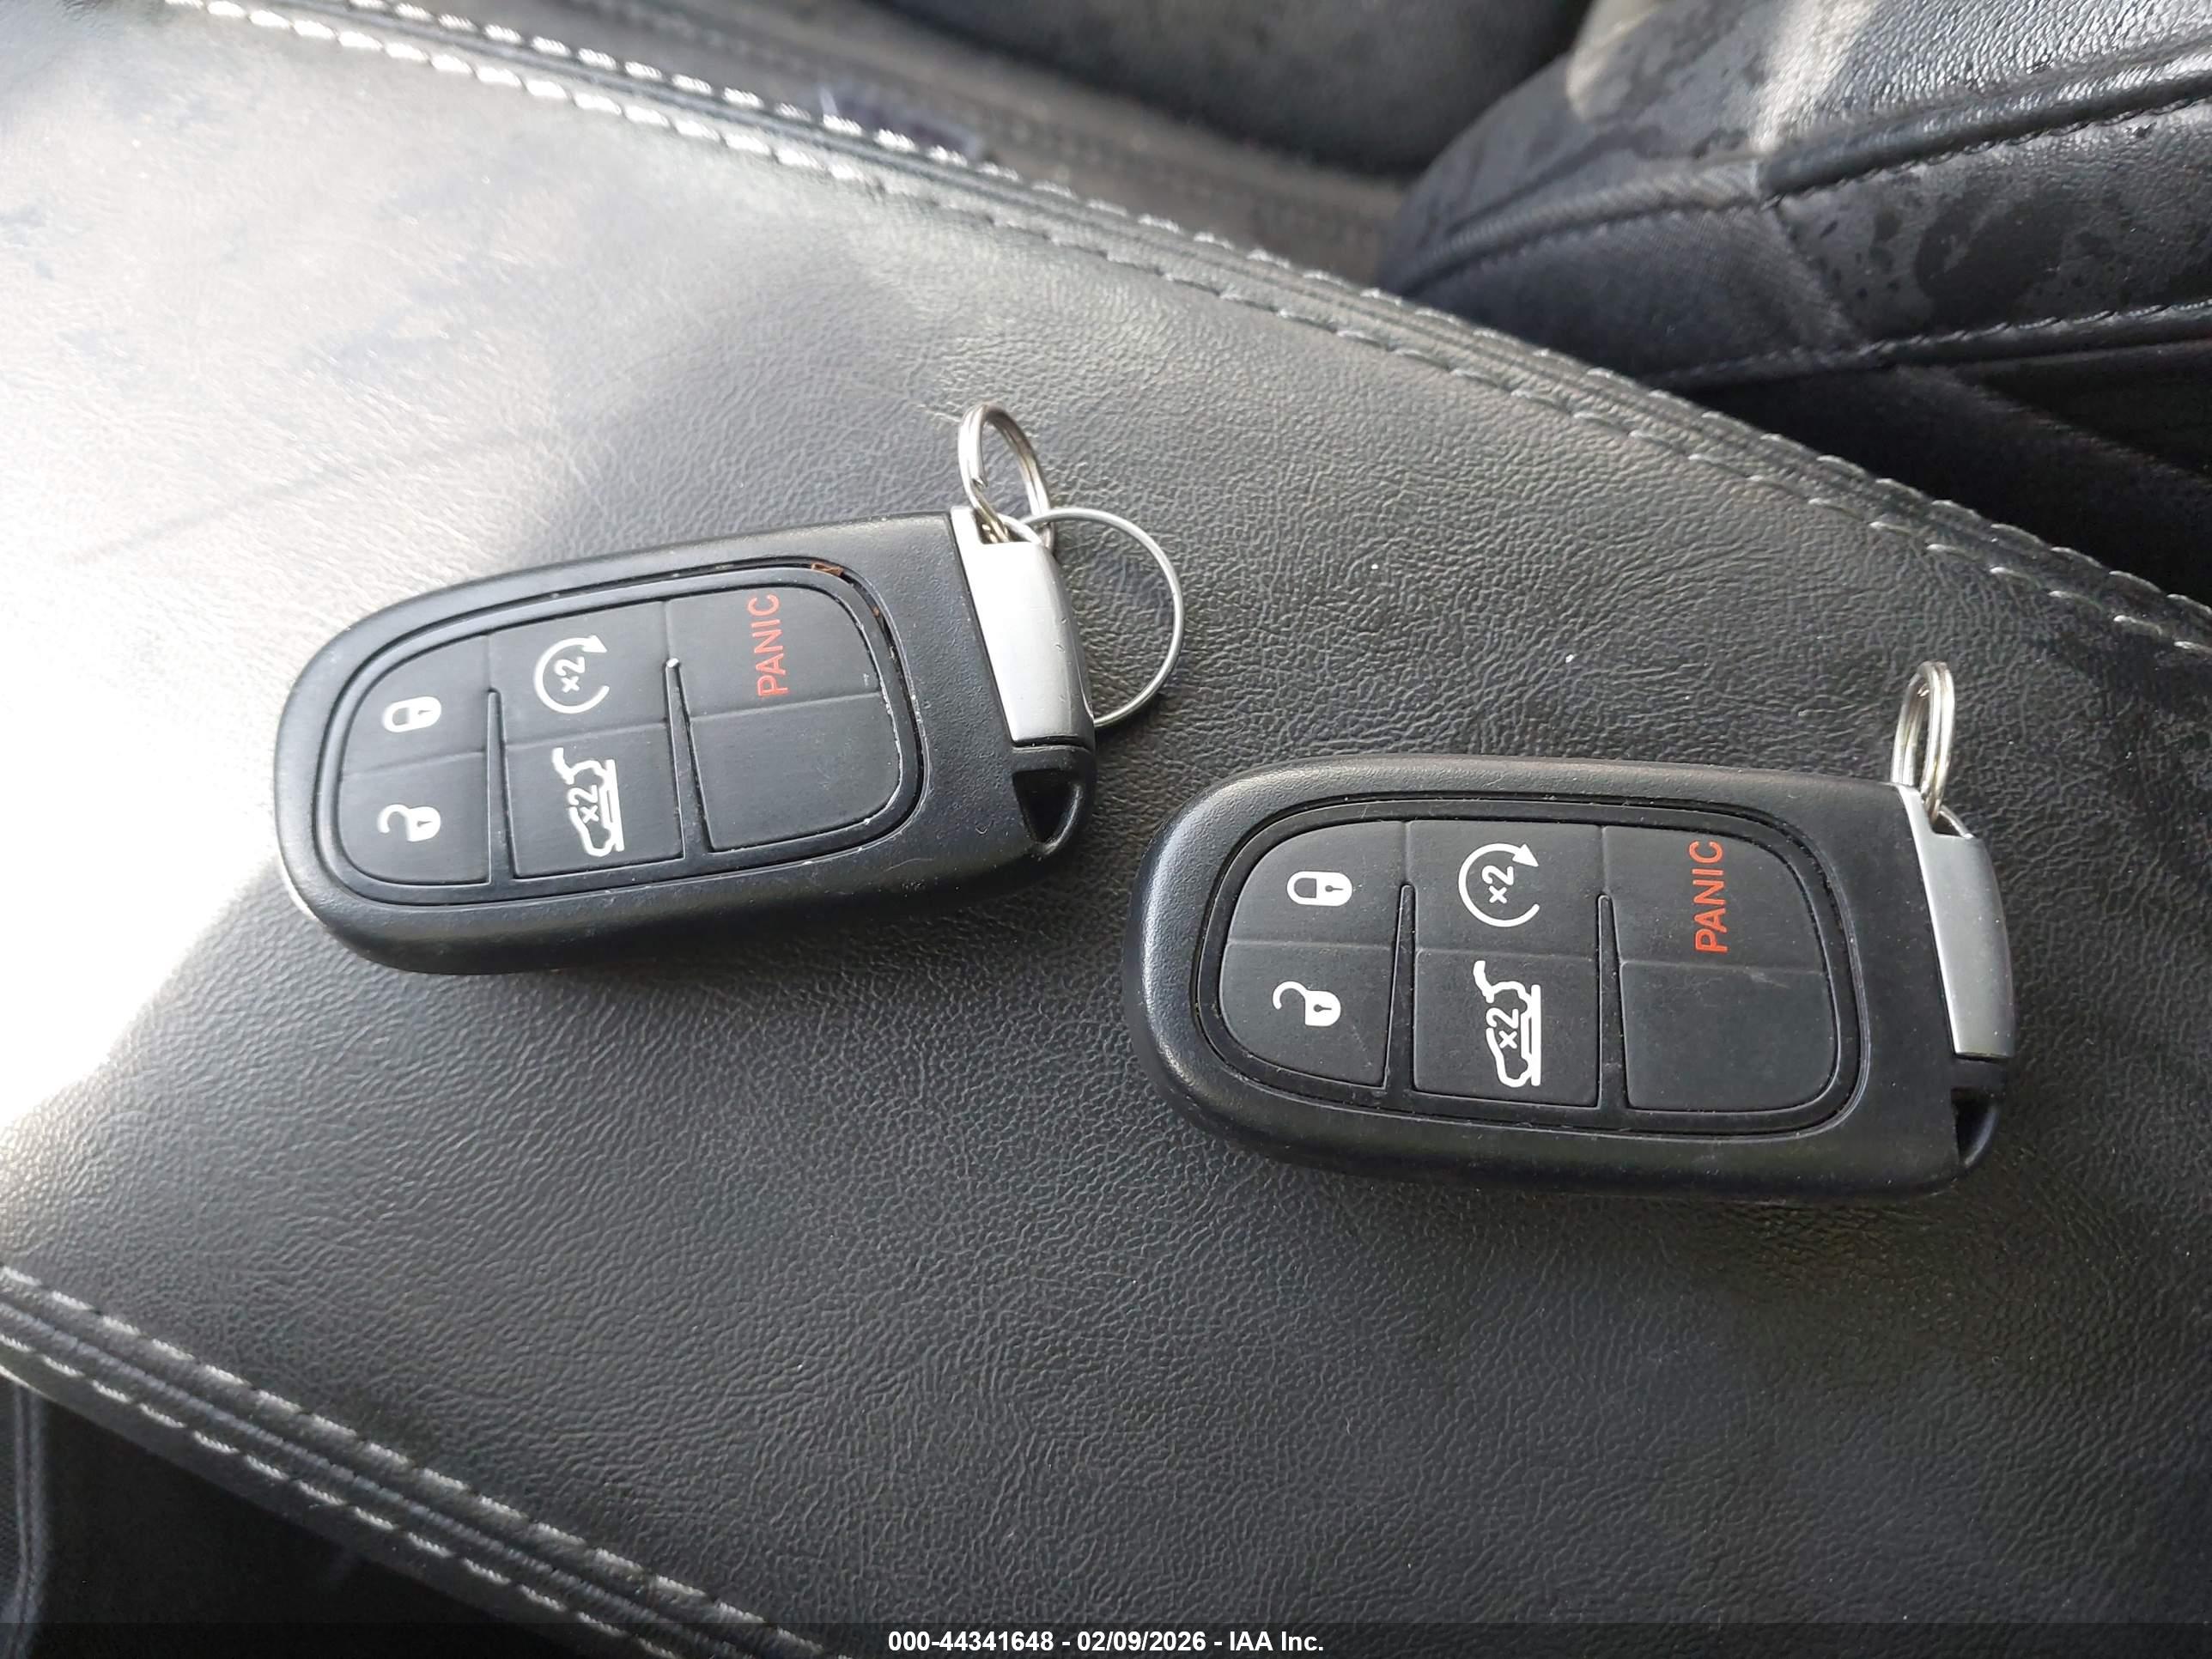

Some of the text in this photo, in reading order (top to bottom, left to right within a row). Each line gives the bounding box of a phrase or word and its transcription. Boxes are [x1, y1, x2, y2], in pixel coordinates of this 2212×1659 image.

[749, 593, 789, 698] PANIC
[554, 656, 586, 693] x2
[567, 784, 599, 823] x2
[1481, 865, 1514, 904] x2
[1688, 840, 1729, 955] PANIC
[1486, 1007, 1520, 1049] x2
